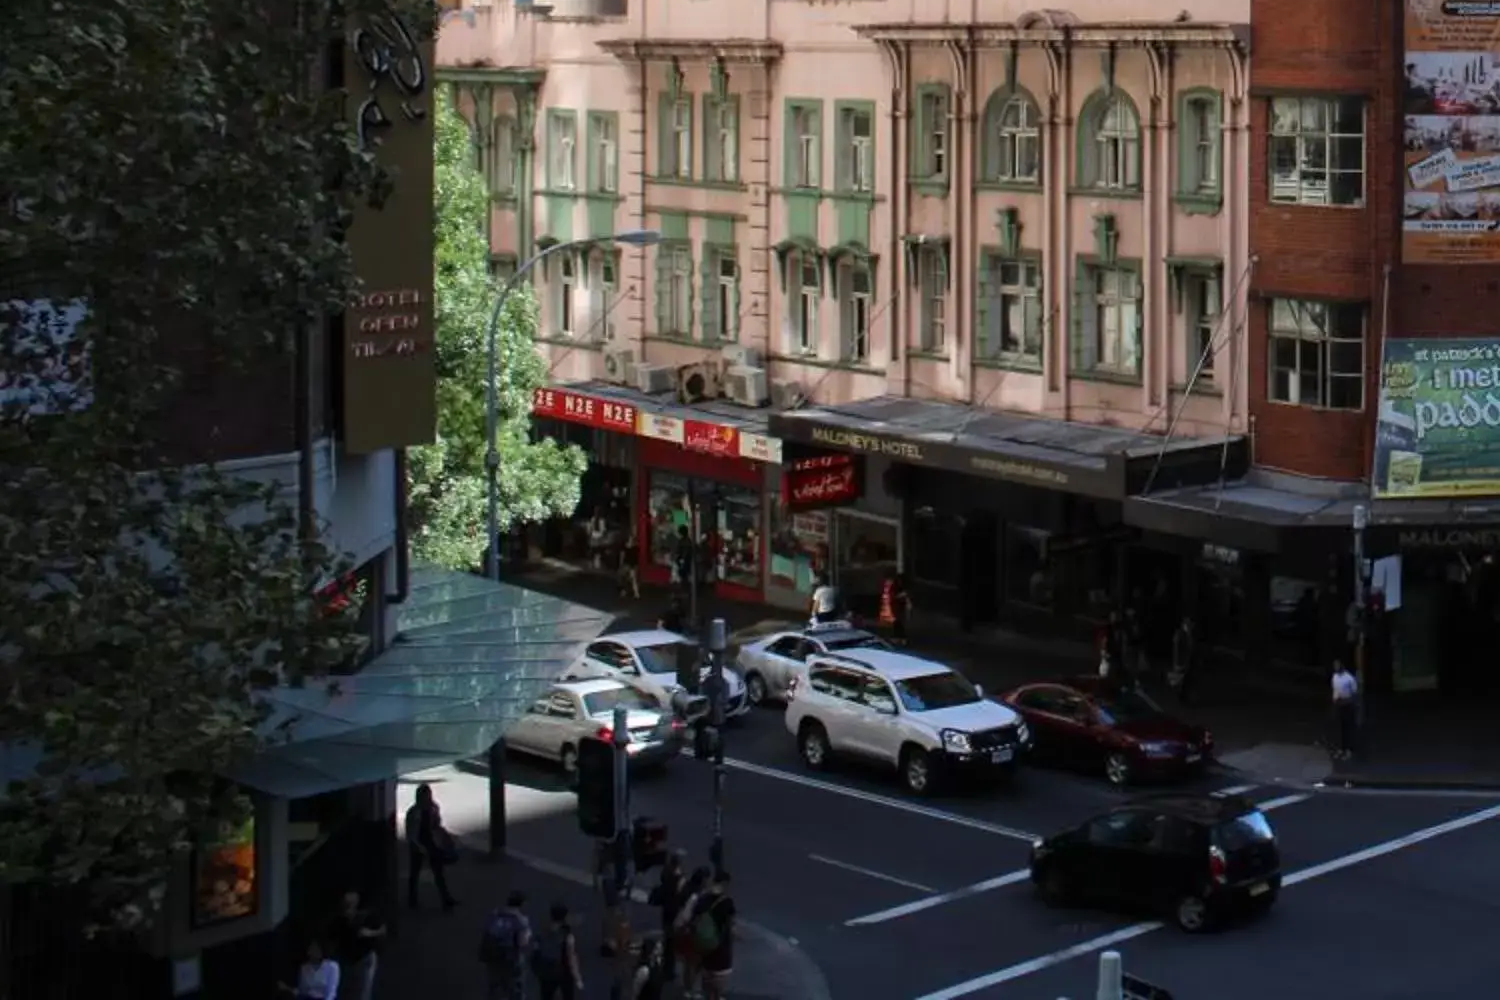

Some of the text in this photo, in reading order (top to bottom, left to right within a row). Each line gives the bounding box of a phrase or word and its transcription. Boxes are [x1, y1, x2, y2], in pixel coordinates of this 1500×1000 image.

[565, 395, 594, 415] N2E
[603, 404, 633, 424] N2E
[812, 427, 923, 460] MALONEY'S HOTEL
